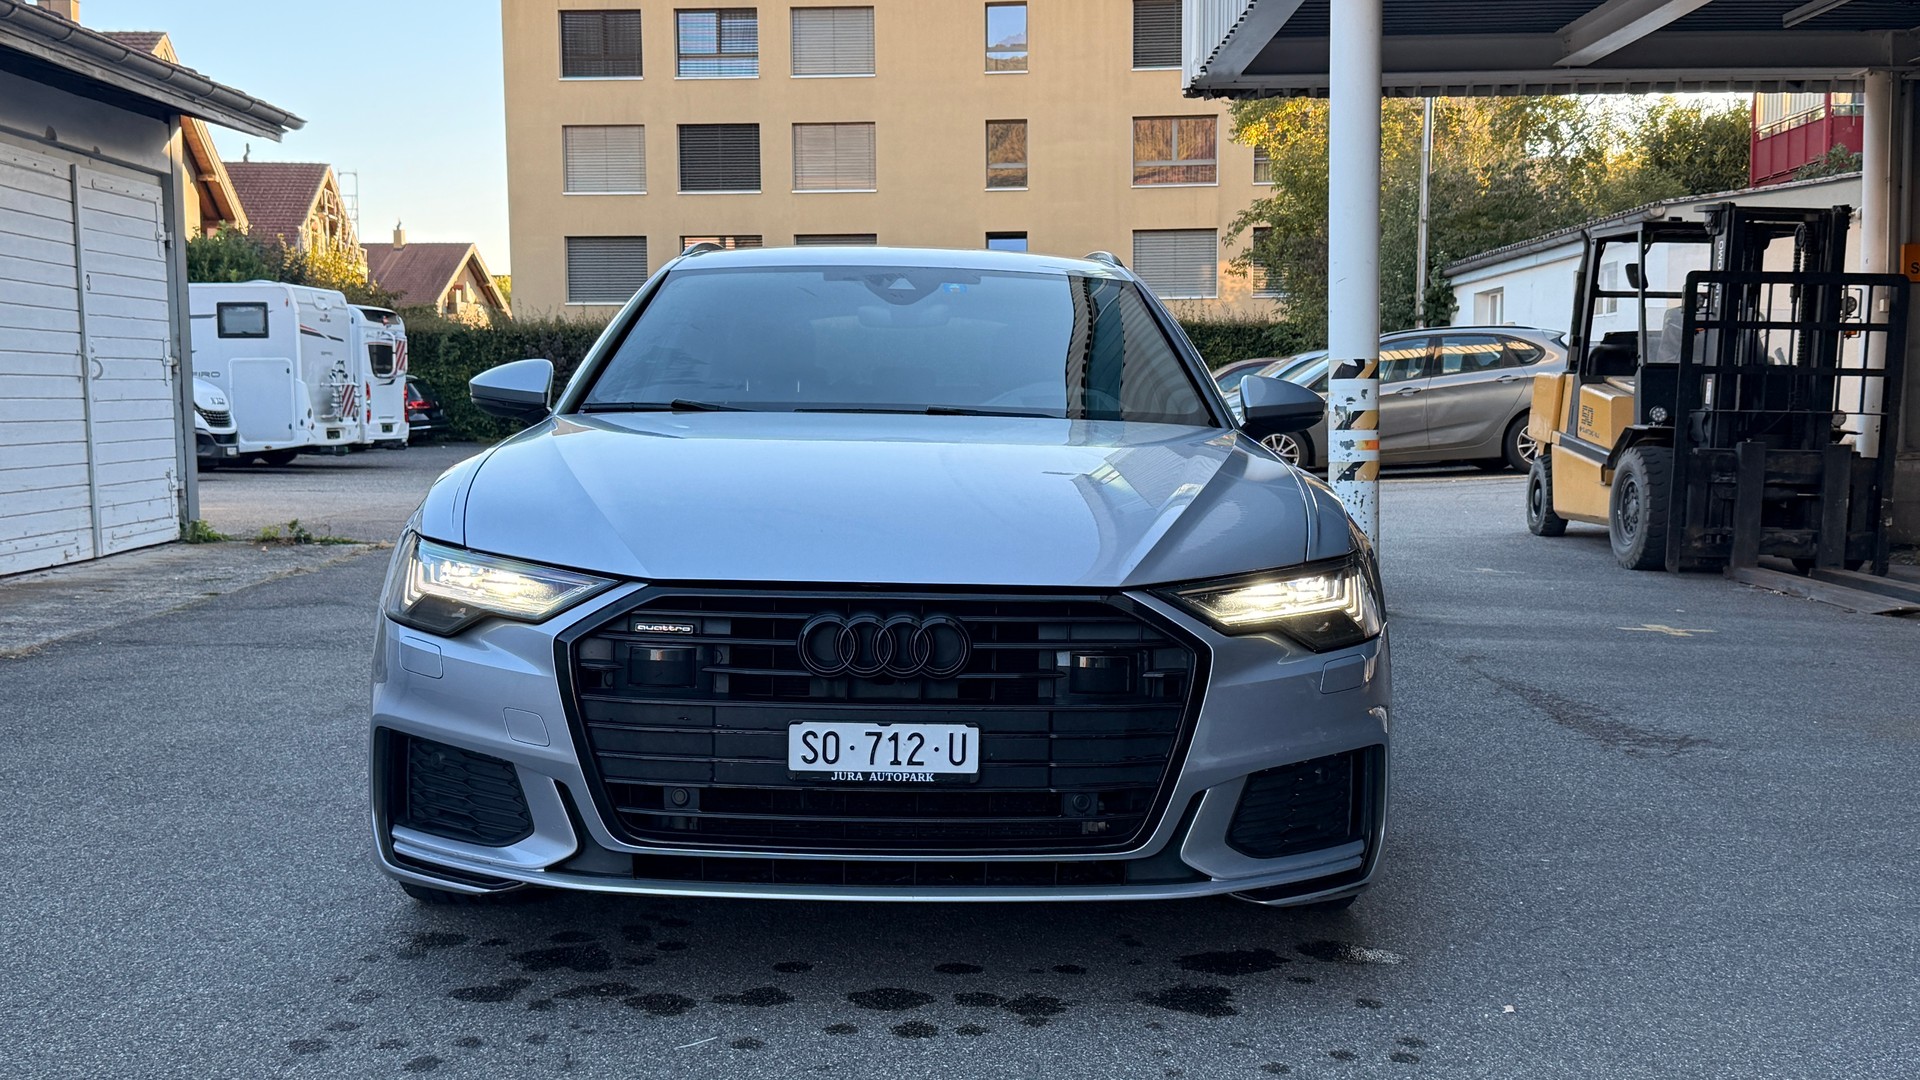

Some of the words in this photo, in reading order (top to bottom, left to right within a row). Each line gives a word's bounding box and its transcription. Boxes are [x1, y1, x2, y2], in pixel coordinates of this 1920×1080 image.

[86, 273, 91, 291] 3
[637, 624, 691, 632] quattro
[831, 771, 863, 782] JURA
[869, 772, 935, 782] AUTOPARK
